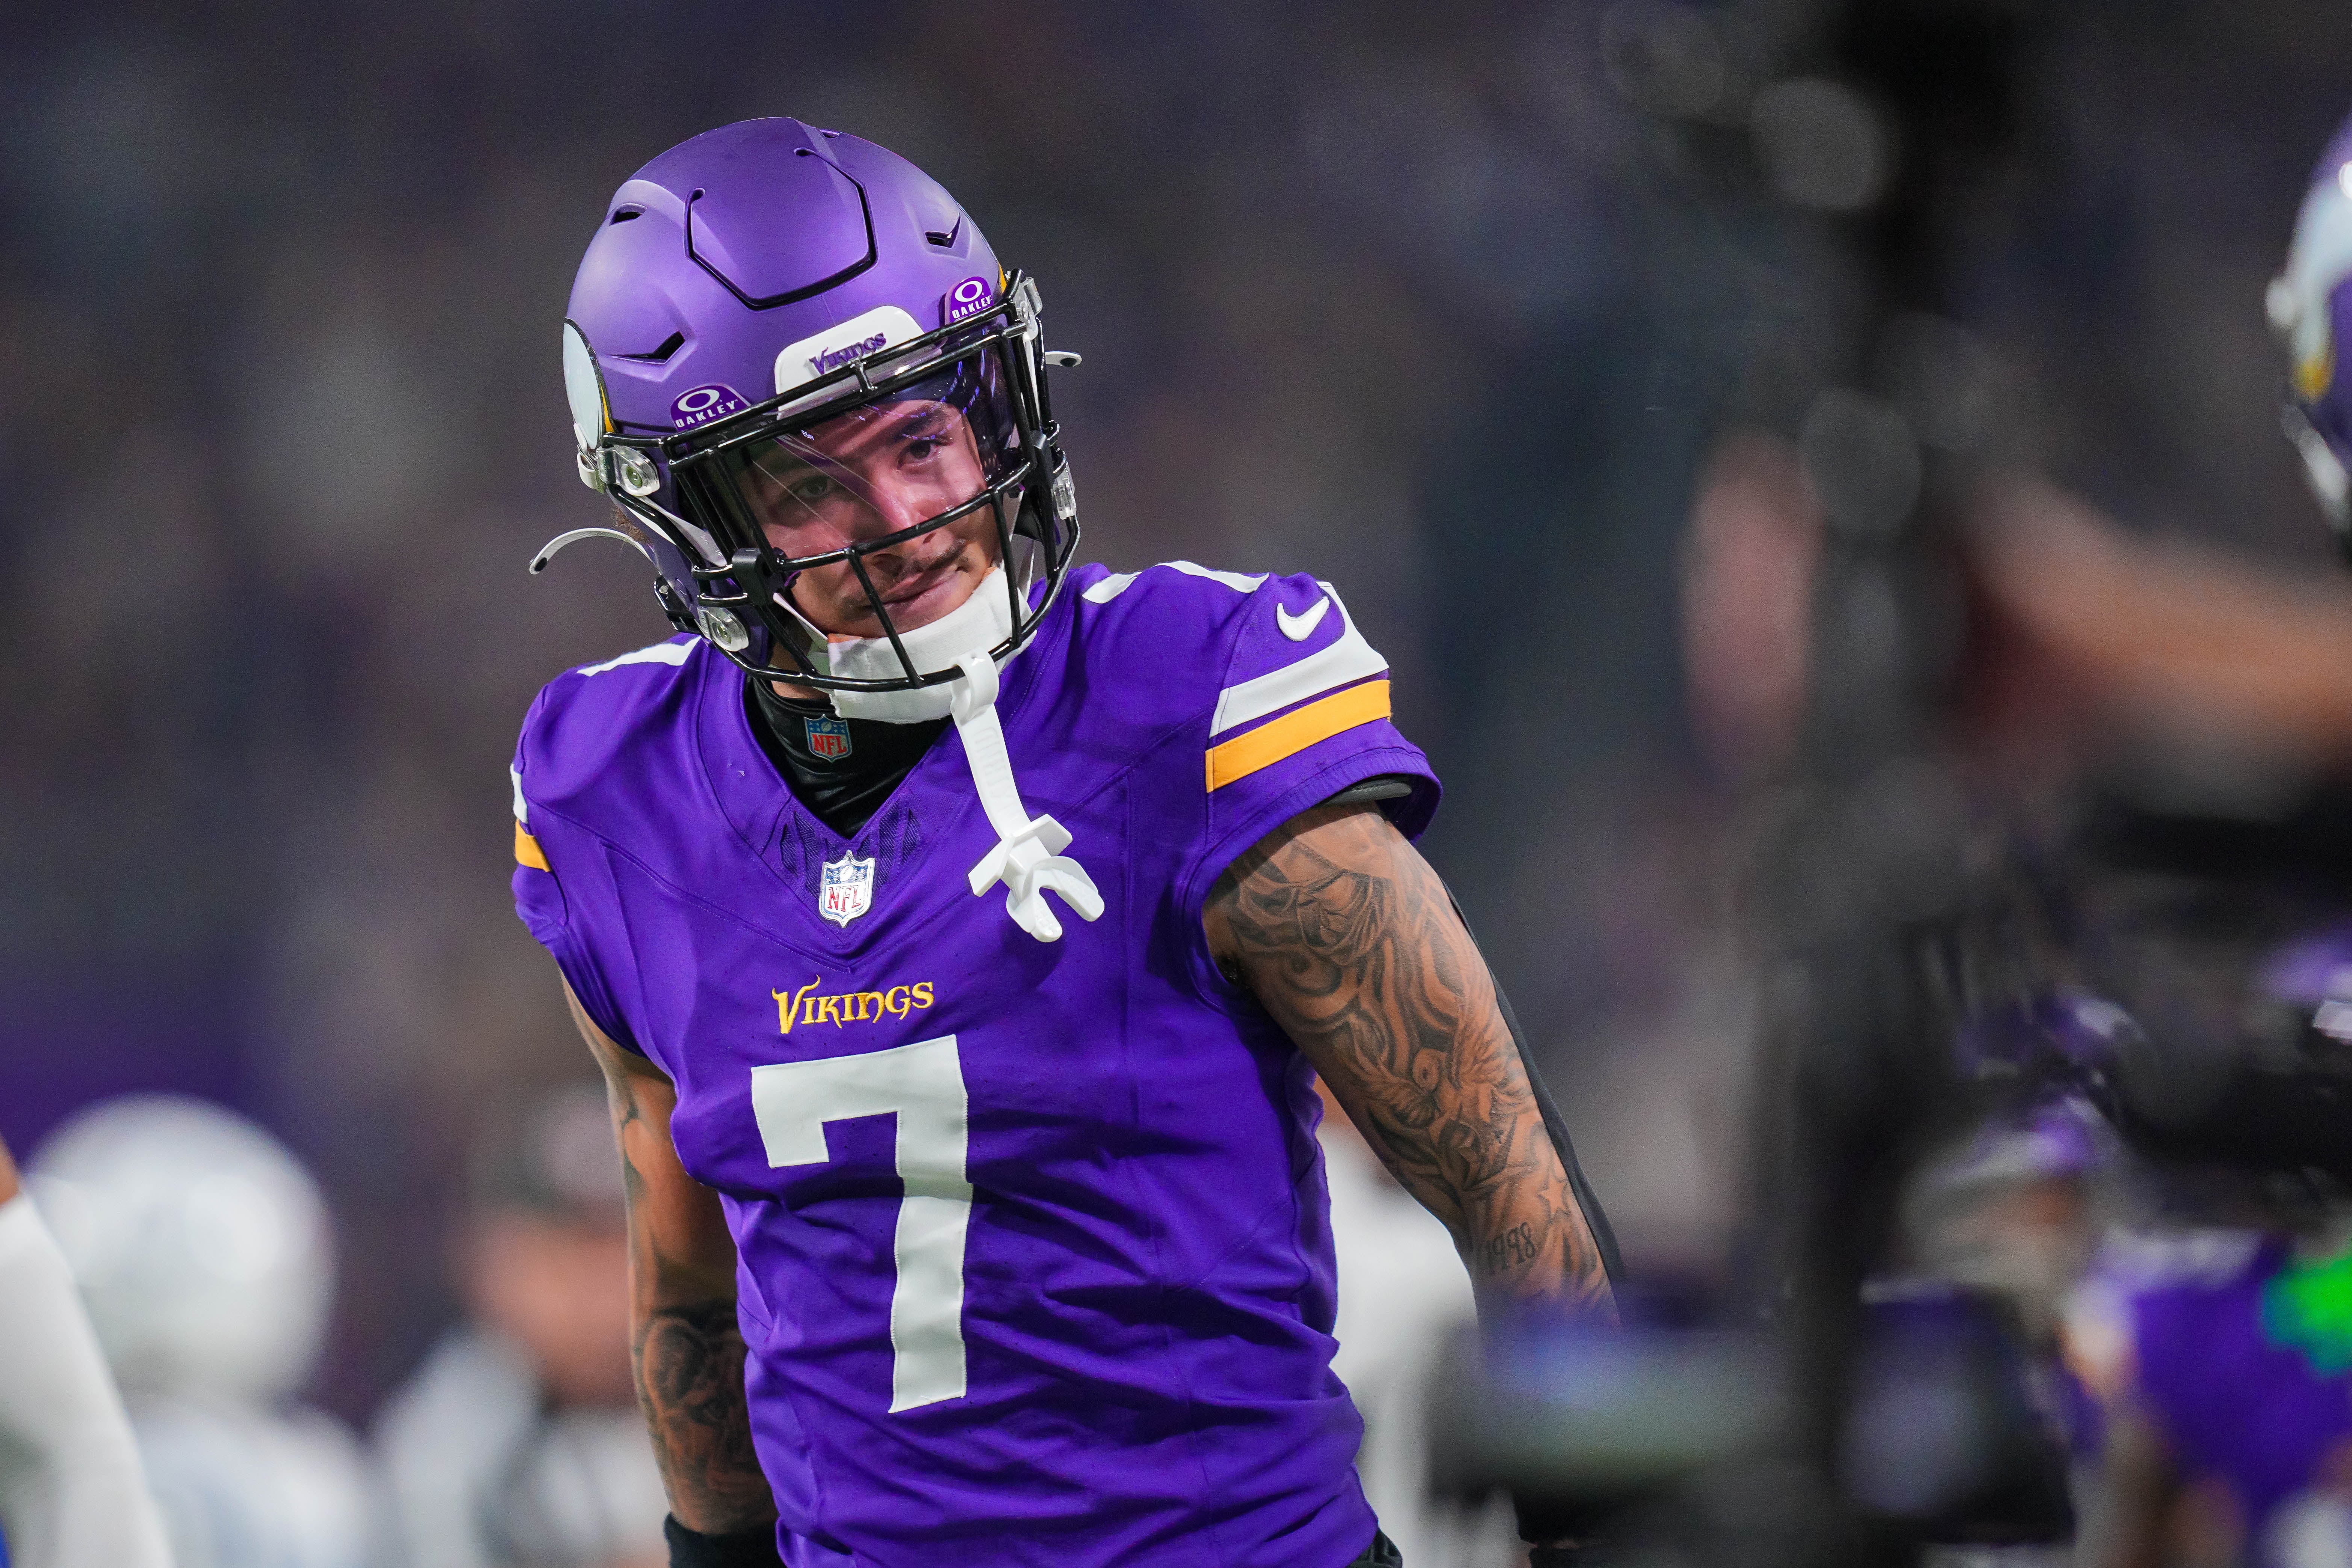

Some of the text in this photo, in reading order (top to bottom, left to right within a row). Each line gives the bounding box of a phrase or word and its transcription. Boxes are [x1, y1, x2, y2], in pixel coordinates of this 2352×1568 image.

[952, 295, 992, 319] OAKLEY
[808, 332, 886, 376] VIKINGS
[675, 400, 736, 428] OAKLEY
[812, 734, 847, 756] NFL
[827, 885, 862, 912] NFL
[771, 974, 935, 1034] VIKINGS
[751, 1033, 974, 1414] 7
[1487, 1221, 1536, 1275] 1998
